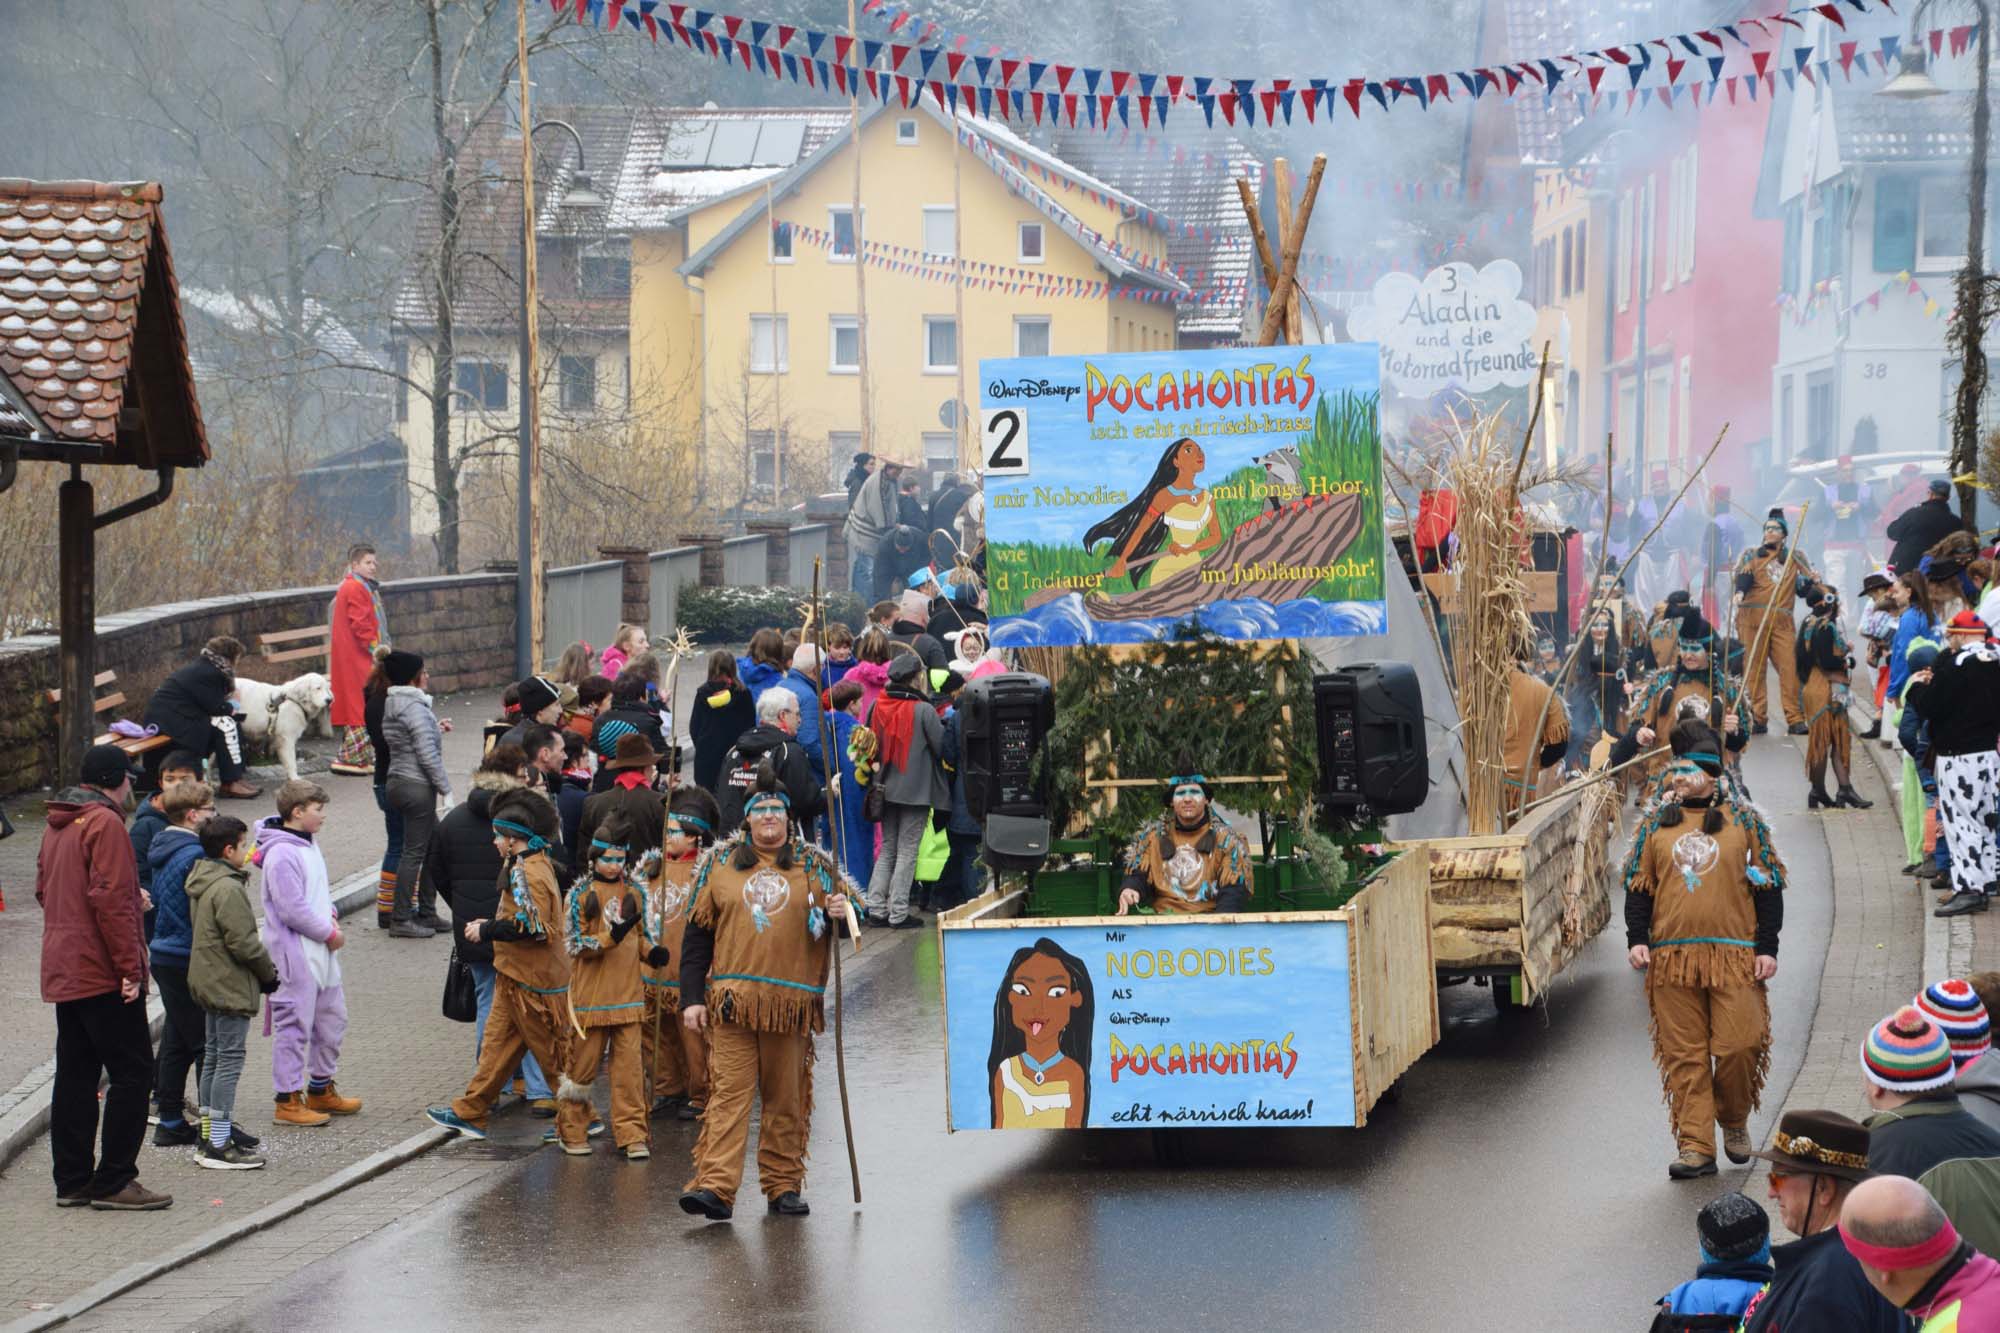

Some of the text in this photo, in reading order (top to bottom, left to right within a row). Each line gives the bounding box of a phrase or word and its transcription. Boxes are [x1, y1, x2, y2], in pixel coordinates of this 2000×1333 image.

[1441, 267, 1457, 293] 3
[1400, 290, 1502, 326] Aladin
[1415, 326, 1494, 347] und die
[1863, 362, 1887, 380] 38
[1085, 354, 1315, 423] POCAHONTAS
[988, 410, 1023, 469] 2
[1090, 421, 1128, 441] isch
[1132, 417, 1175, 439] echt
[993, 483, 1129, 509] mir Nobodies
[1213, 475, 1370, 502] mit longe Hoor,
[996, 543, 1028, 563] wie
[1022, 569, 1105, 591] Indianer
[1201, 556, 1376, 586] im Jubiläumsjohr!
[1106, 931, 1127, 943] Mir
[1106, 946, 1275, 979] NOBODIES
[1112, 988, 1133, 1000] ALS
[1109, 1031, 1298, 1084] POCAHONTAS
[1110, 1099, 1314, 1123] echt närrisch krass!
